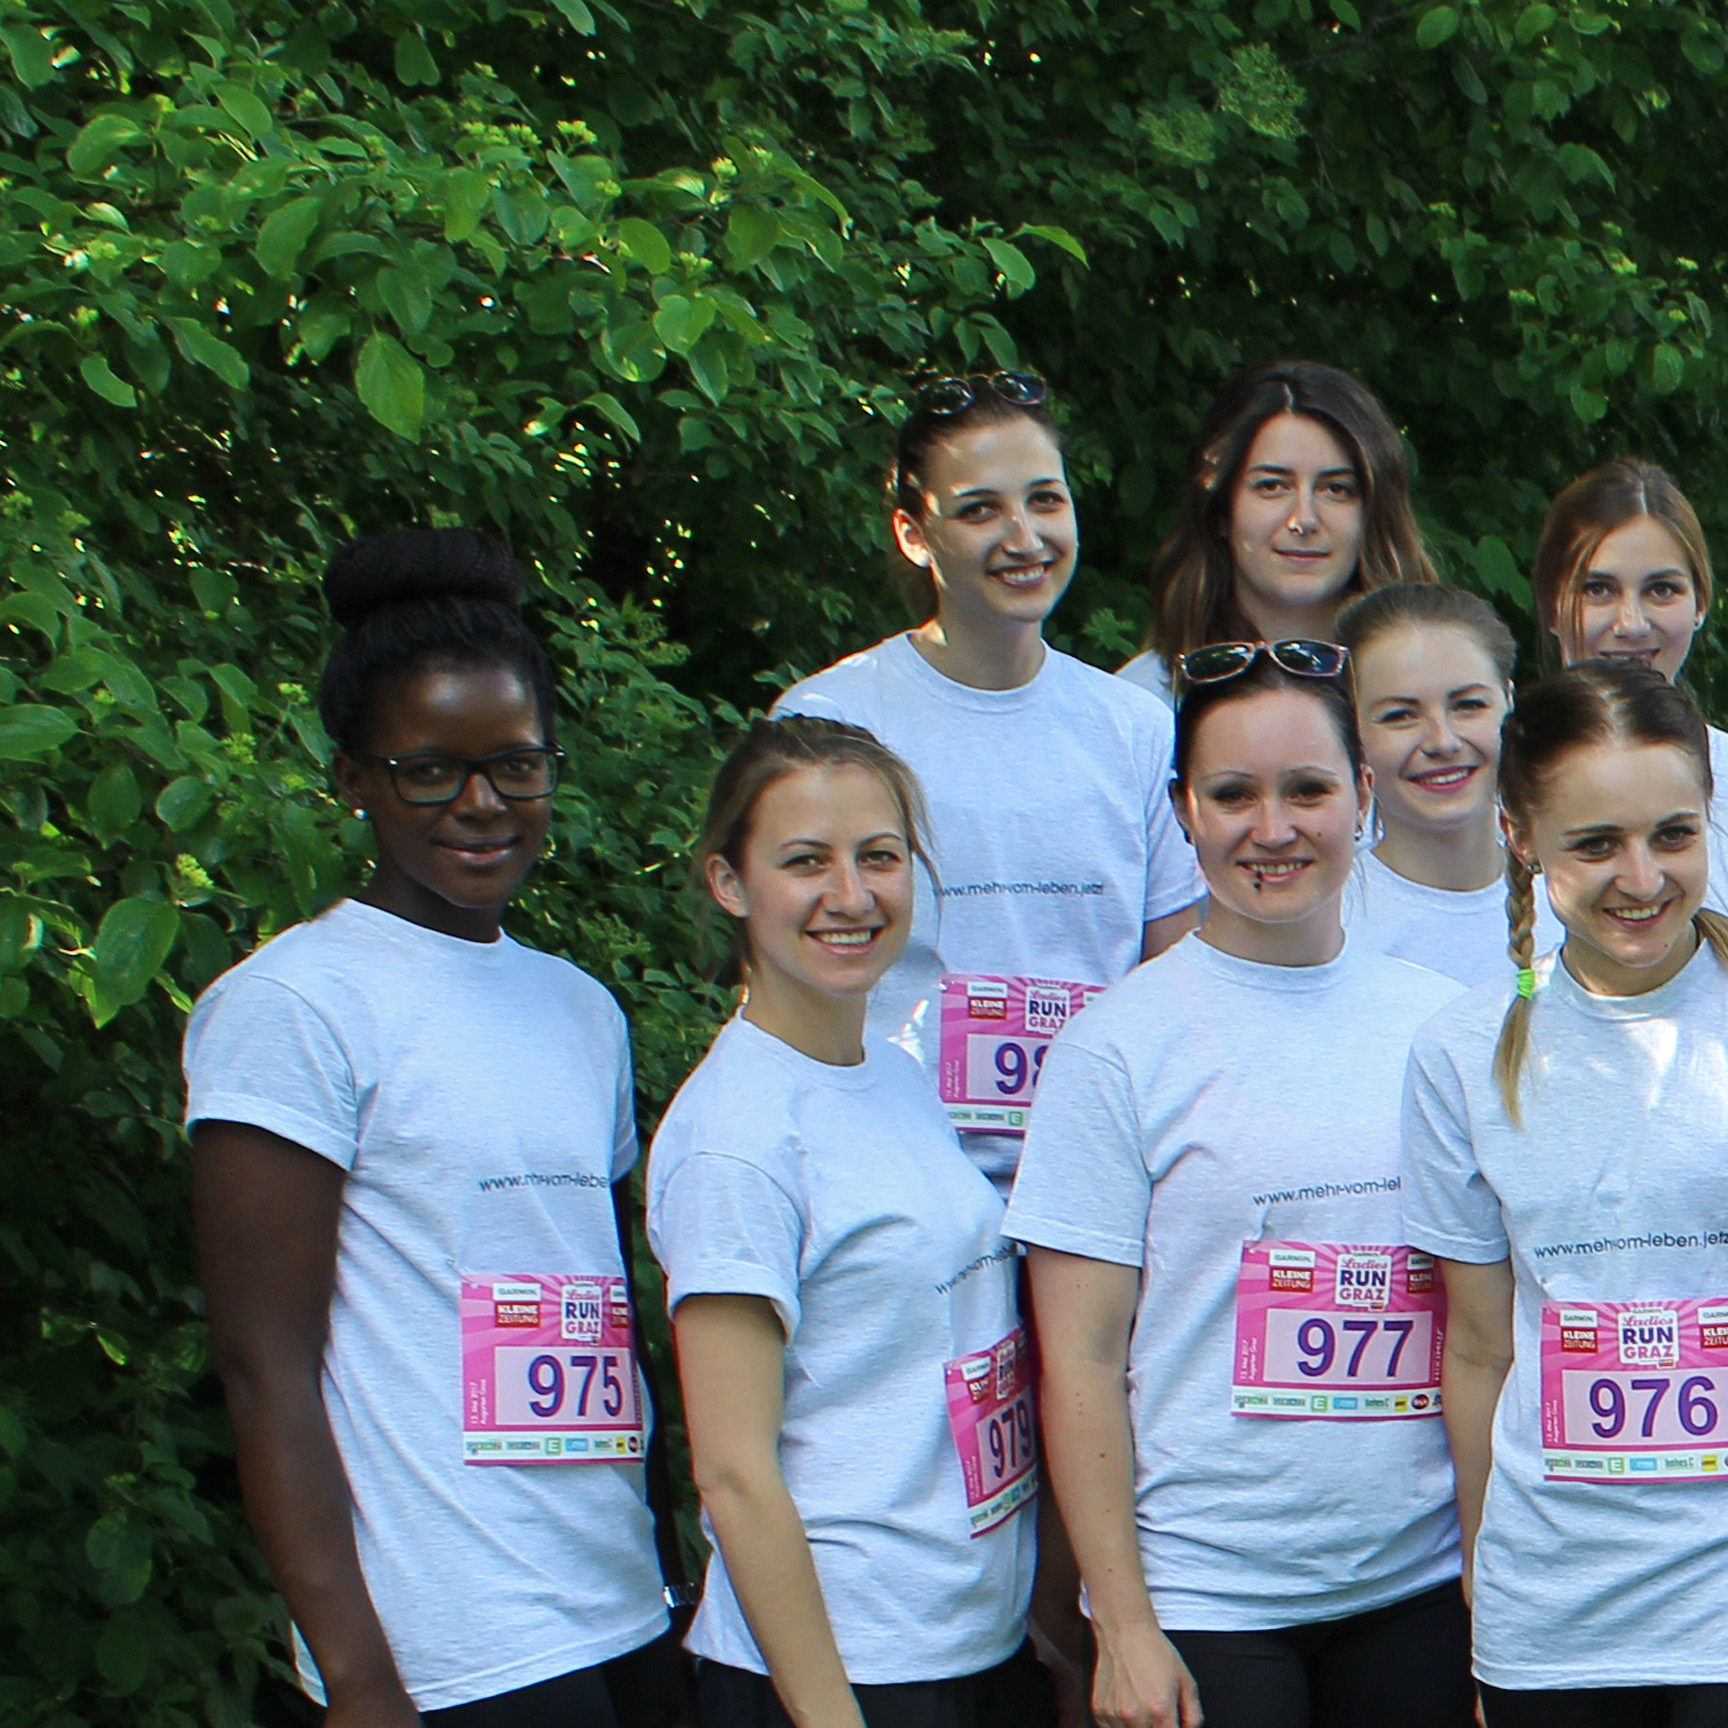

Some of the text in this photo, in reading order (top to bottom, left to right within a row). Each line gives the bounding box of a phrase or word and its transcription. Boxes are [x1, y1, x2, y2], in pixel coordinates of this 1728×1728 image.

[1029, 1001, 1067, 1017] RUN
[1342, 1258, 1388, 1269] Ladies
[1273, 1270, 1311, 1280] KLEINE
[1340, 1270, 1386, 1286] RUN
[1273, 1279, 1311, 1289] ZEITUNG
[1339, 1288, 1385, 1300] GRAZ
[566, 1302, 600, 1319] RUN
[1622, 1315, 1673, 1326] Ladies
[1563, 1331, 1596, 1341] KLEINE
[1623, 1327, 1673, 1345] RUN
[1297, 1318, 1414, 1378] 977
[1563, 1339, 1596, 1350] ZEITUNG
[1624, 1345, 1674, 1358] GRAZ
[529, 1355, 623, 1417] 975
[1589, 1375, 1718, 1439] 976
[989, 1401, 1032, 1478] 979
